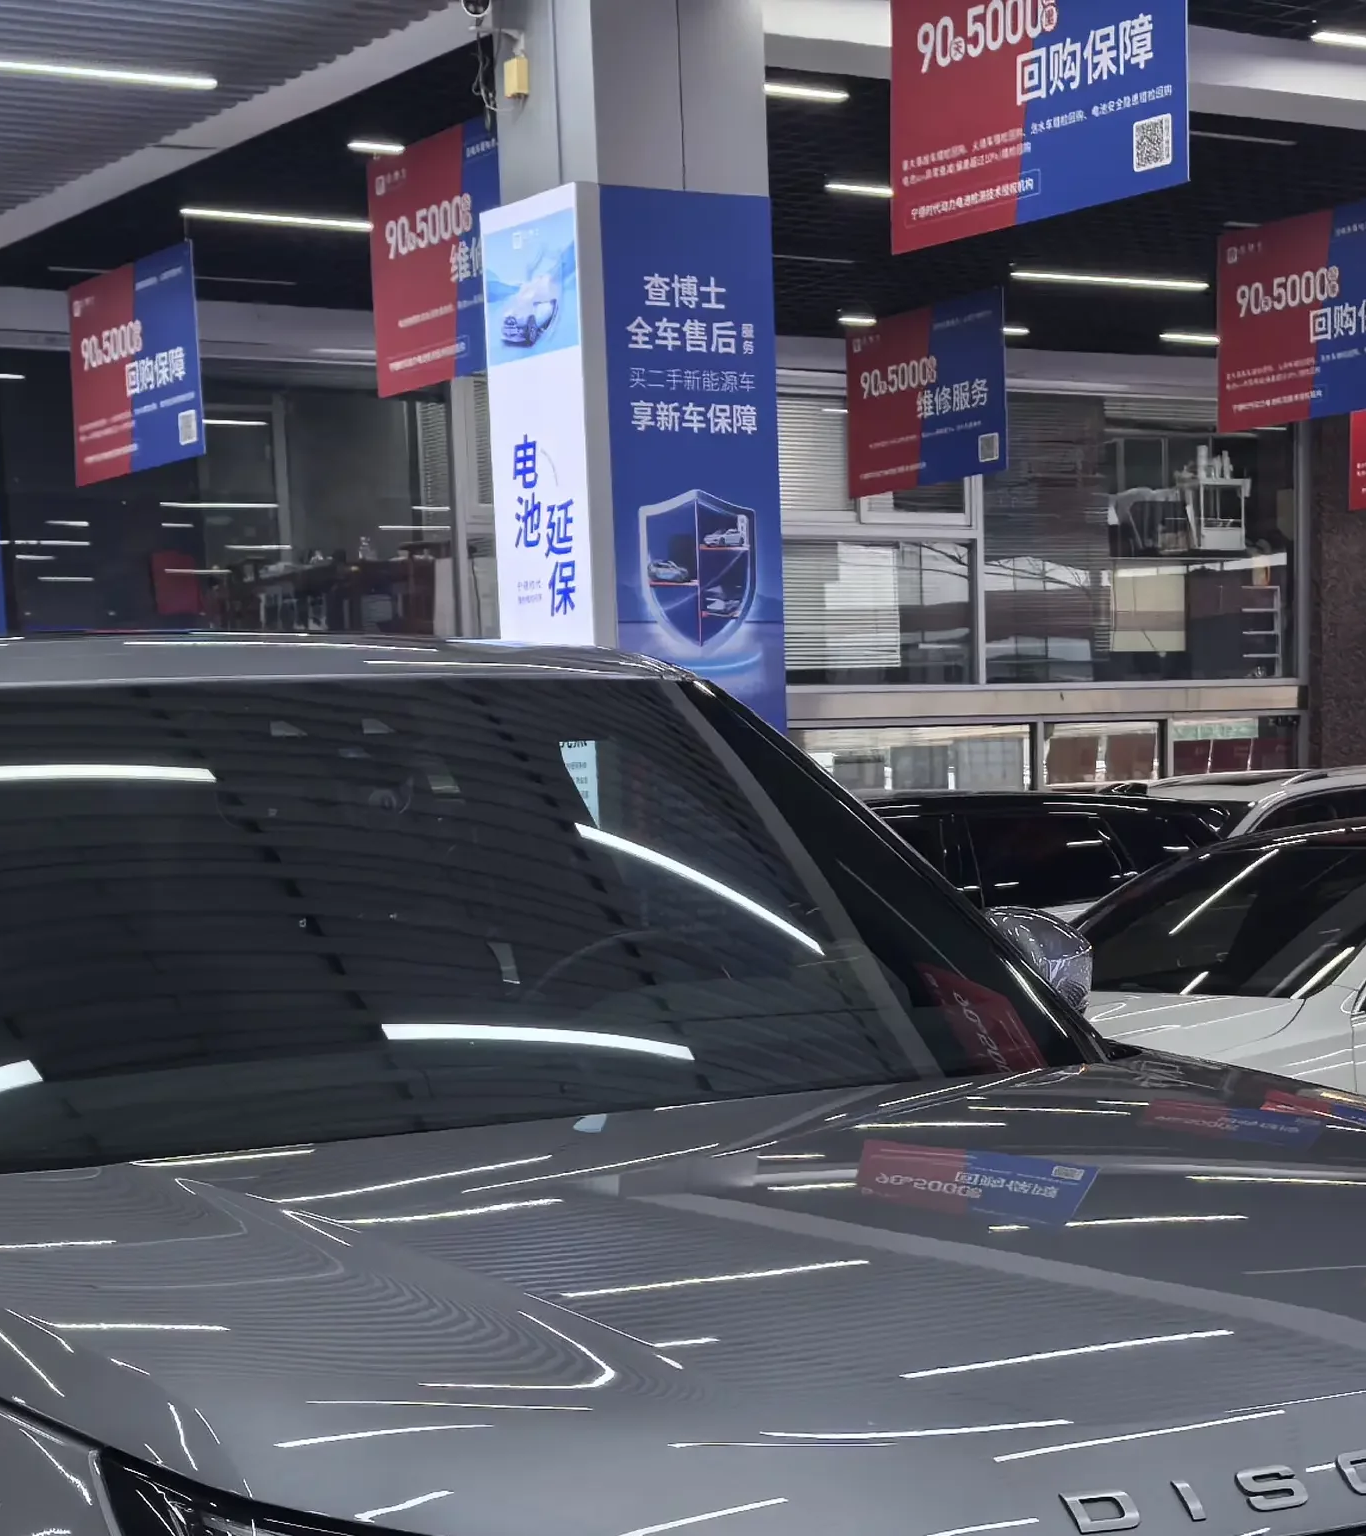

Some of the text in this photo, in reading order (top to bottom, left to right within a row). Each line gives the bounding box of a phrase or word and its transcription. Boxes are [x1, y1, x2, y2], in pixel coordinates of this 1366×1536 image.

[917, 0, 1058, 74] 90天5000里
[1016, 13, 1153, 105] 回购保障
[643, 273, 727, 310] 查博士
[626, 316, 755, 356] 全车售后 服务
[124, 346, 186, 397] 回购保障
[629, 367, 756, 393] 买二手新能源车
[630, 400, 758, 435] 享新车保障
[916, 378, 989, 419] 维修服务
[512, 434, 541, 549] 电池
[545, 499, 576, 617] 延保
